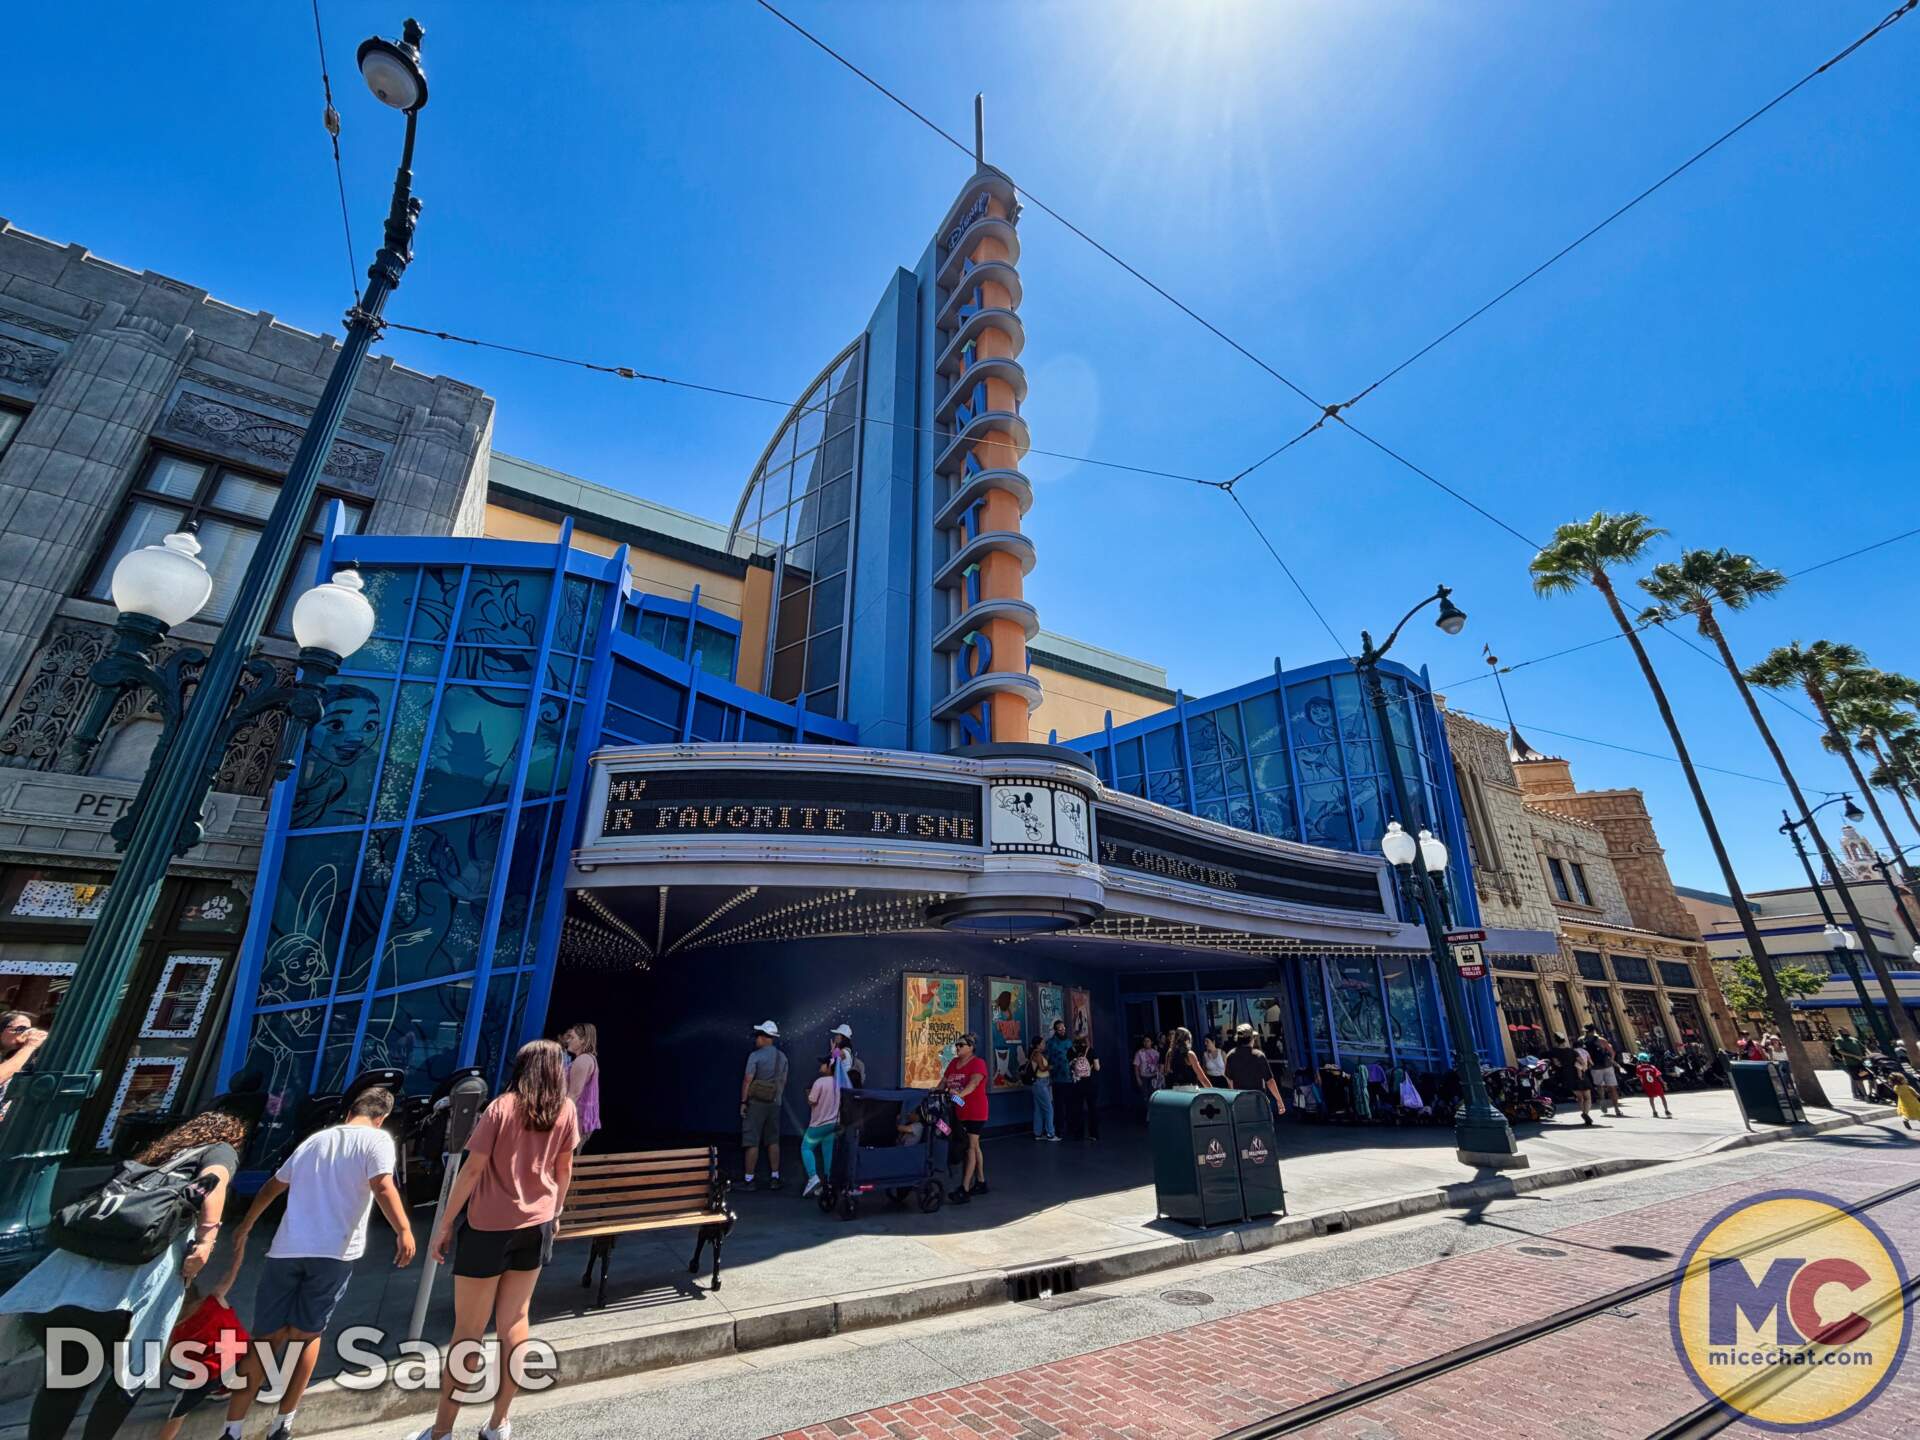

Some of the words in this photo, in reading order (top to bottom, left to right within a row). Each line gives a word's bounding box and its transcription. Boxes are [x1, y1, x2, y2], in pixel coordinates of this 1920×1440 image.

[608, 780, 646, 802] MY
[656, 806, 846, 832] FAVORITE
[1131, 849, 1238, 889] CHARACTERS
[1646, 1071, 1654, 1083] 6
